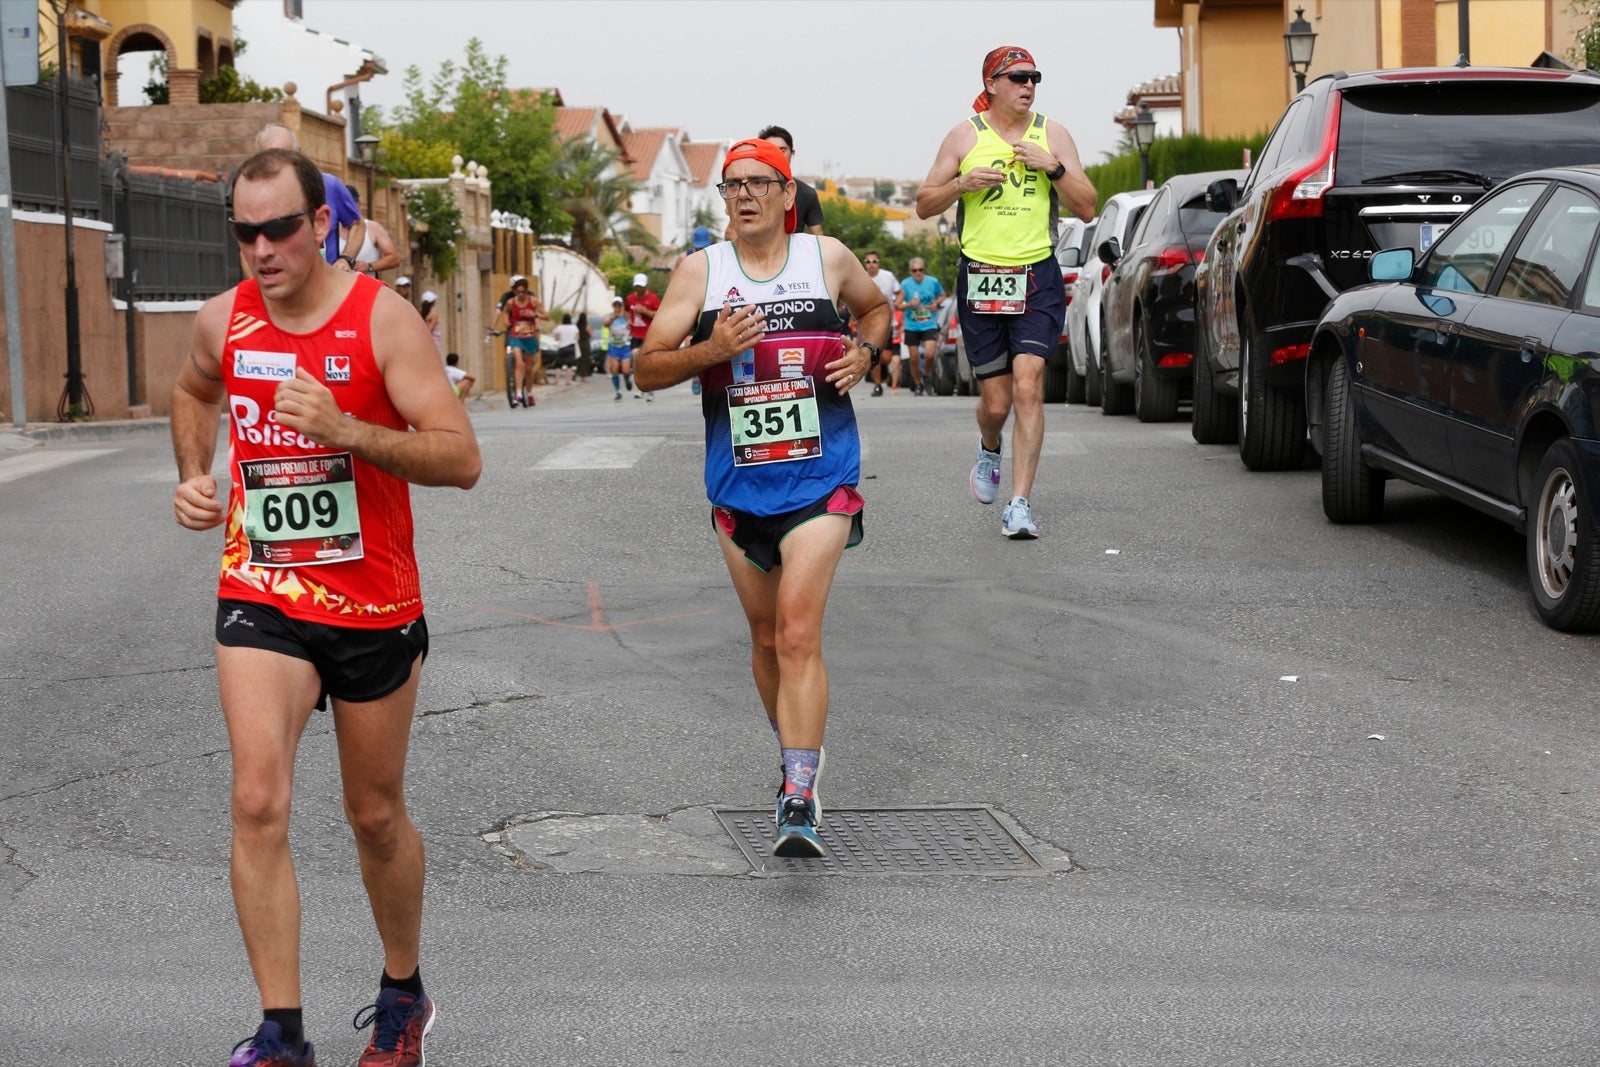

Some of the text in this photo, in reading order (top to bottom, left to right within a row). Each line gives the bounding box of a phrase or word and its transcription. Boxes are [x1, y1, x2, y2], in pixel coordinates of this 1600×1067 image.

[787, 282, 811, 290] YESTE
[977, 276, 1017, 296] 443
[326, 358, 333, 371] I
[744, 385, 760, 396] GRAN
[760, 383, 782, 394] PREMIO
[782, 381, 791, 392] DE
[743, 403, 803, 439] 351
[263, 462, 281, 476] GRAN
[280, 461, 308, 475] PREMIO
[308, 460, 319, 473] DE
[262, 490, 339, 533] 609
